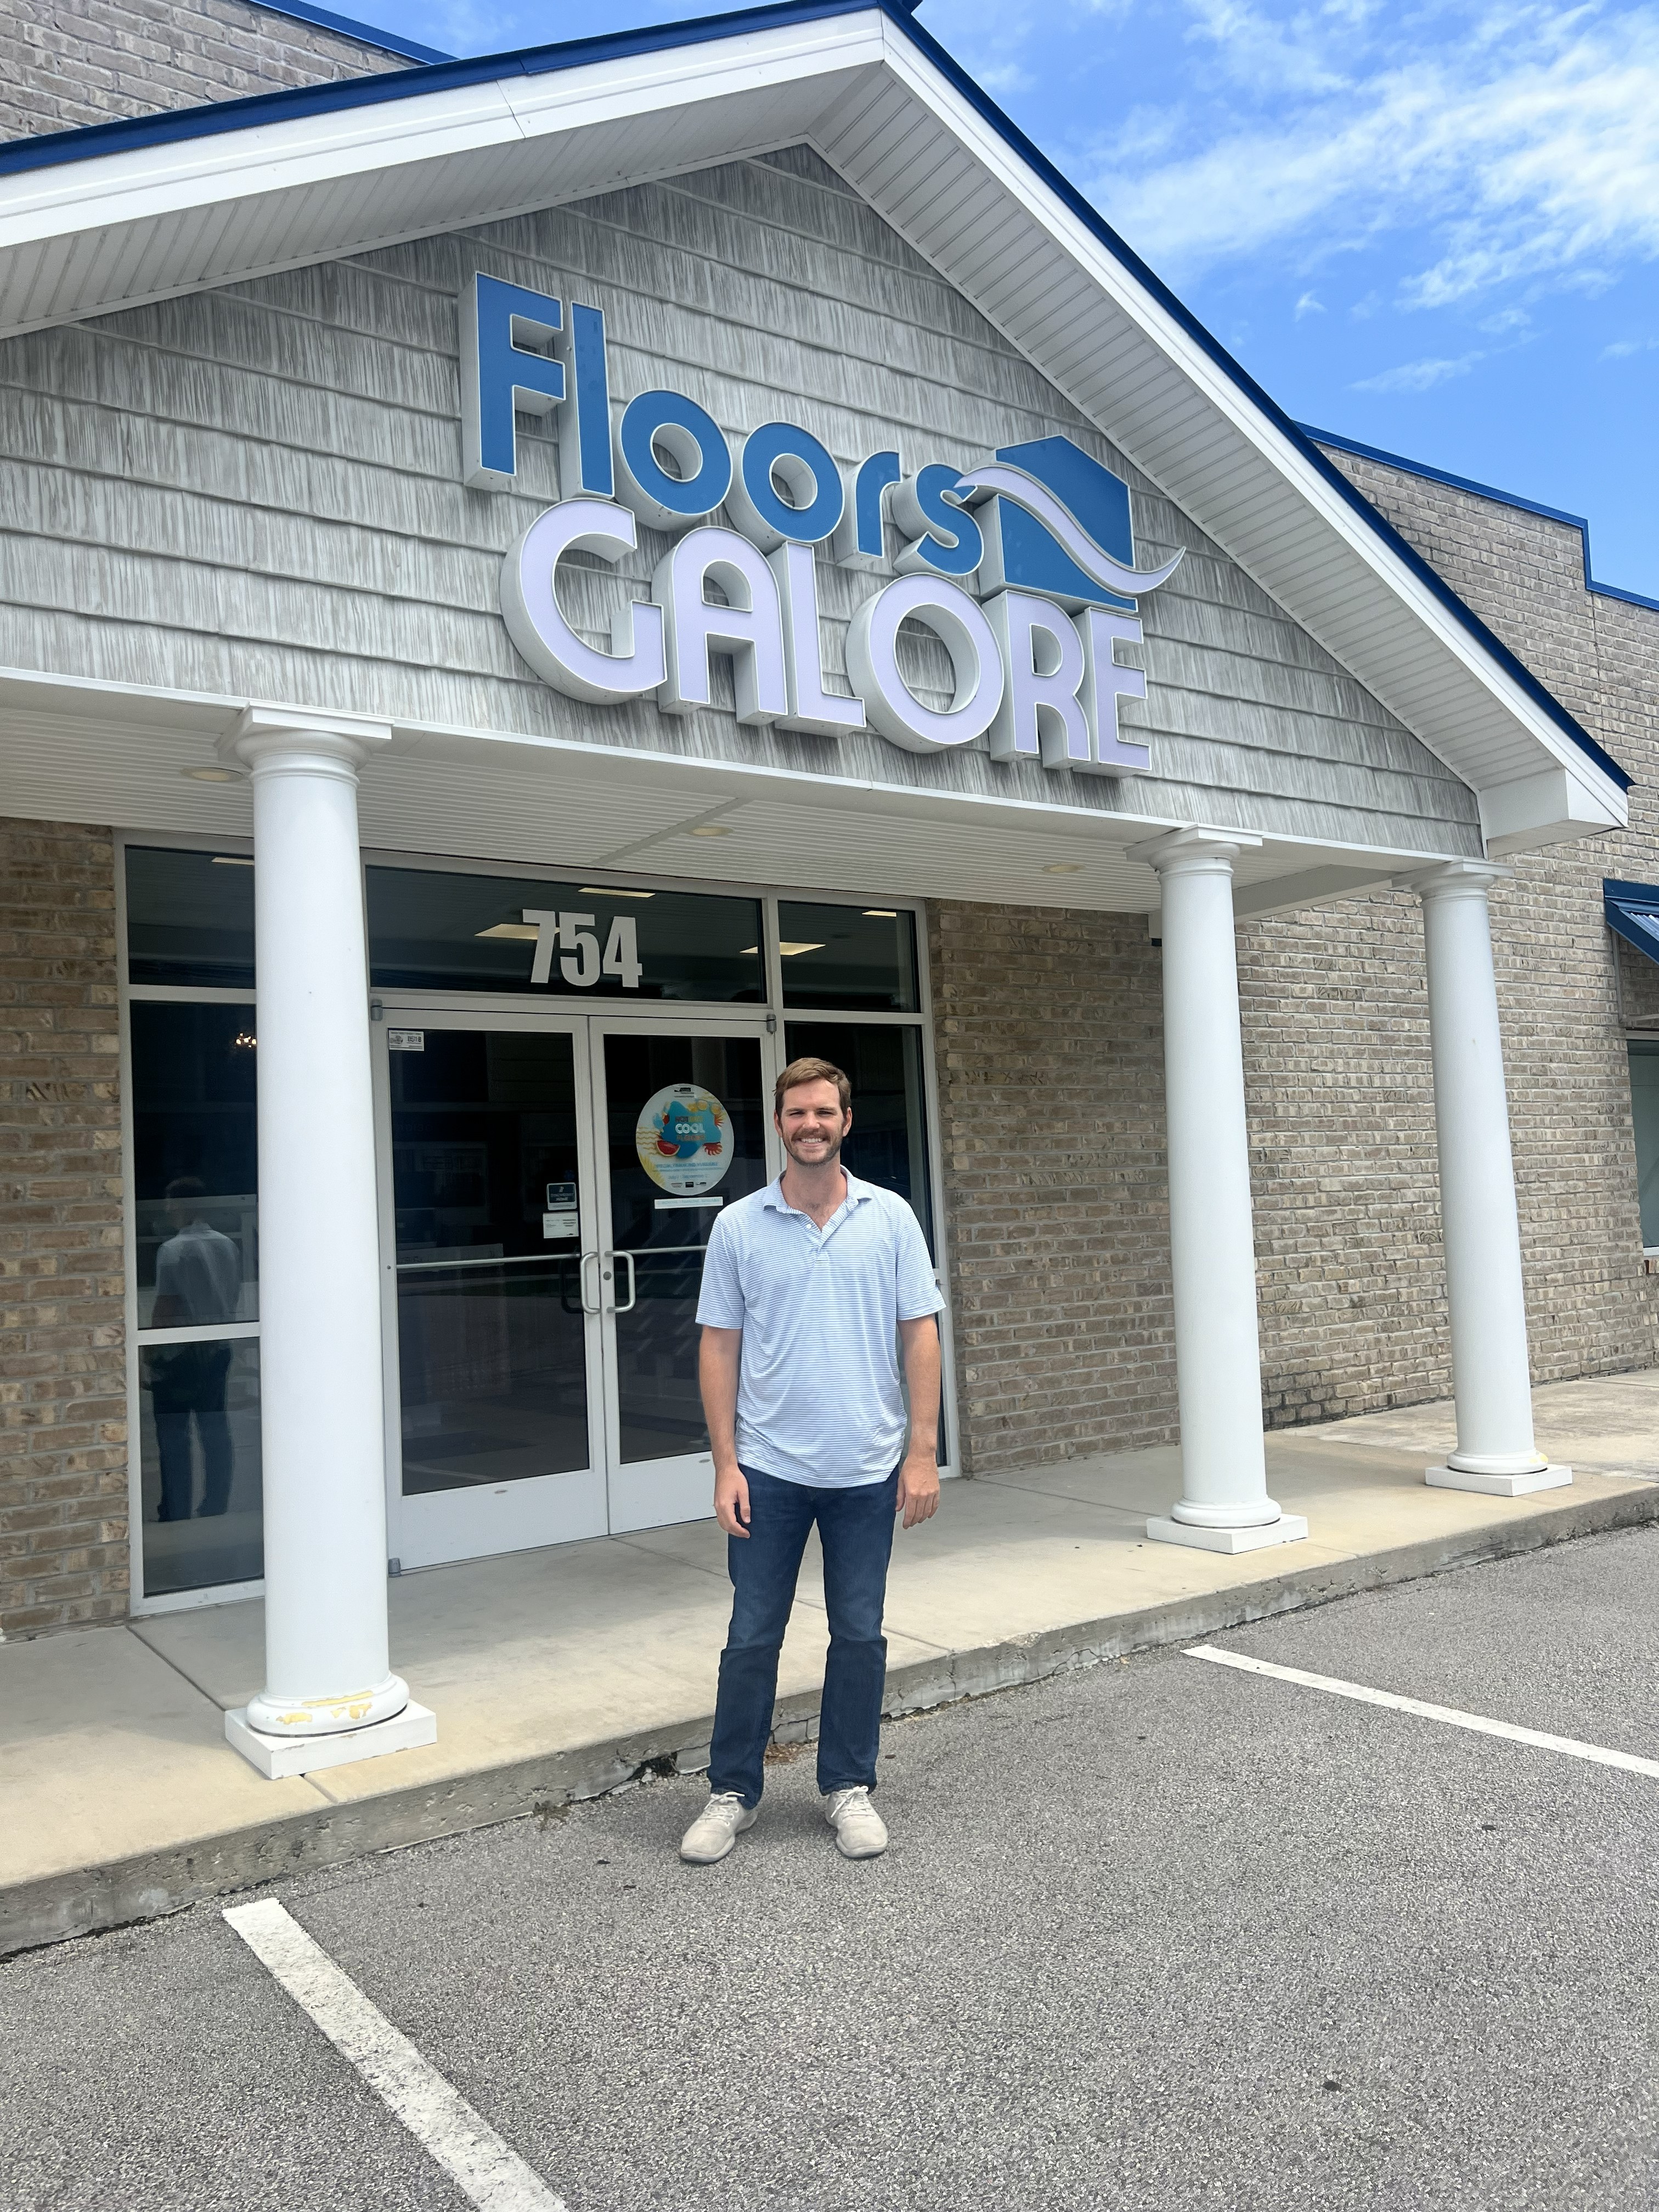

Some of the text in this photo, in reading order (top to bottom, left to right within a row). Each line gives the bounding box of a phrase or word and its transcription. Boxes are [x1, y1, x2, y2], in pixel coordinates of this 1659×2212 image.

[474, 271, 984, 577] Floors
[518, 498, 1152, 771] GALORE
[522, 909, 643, 988] 754
[675, 1123, 706, 1135] COOL
